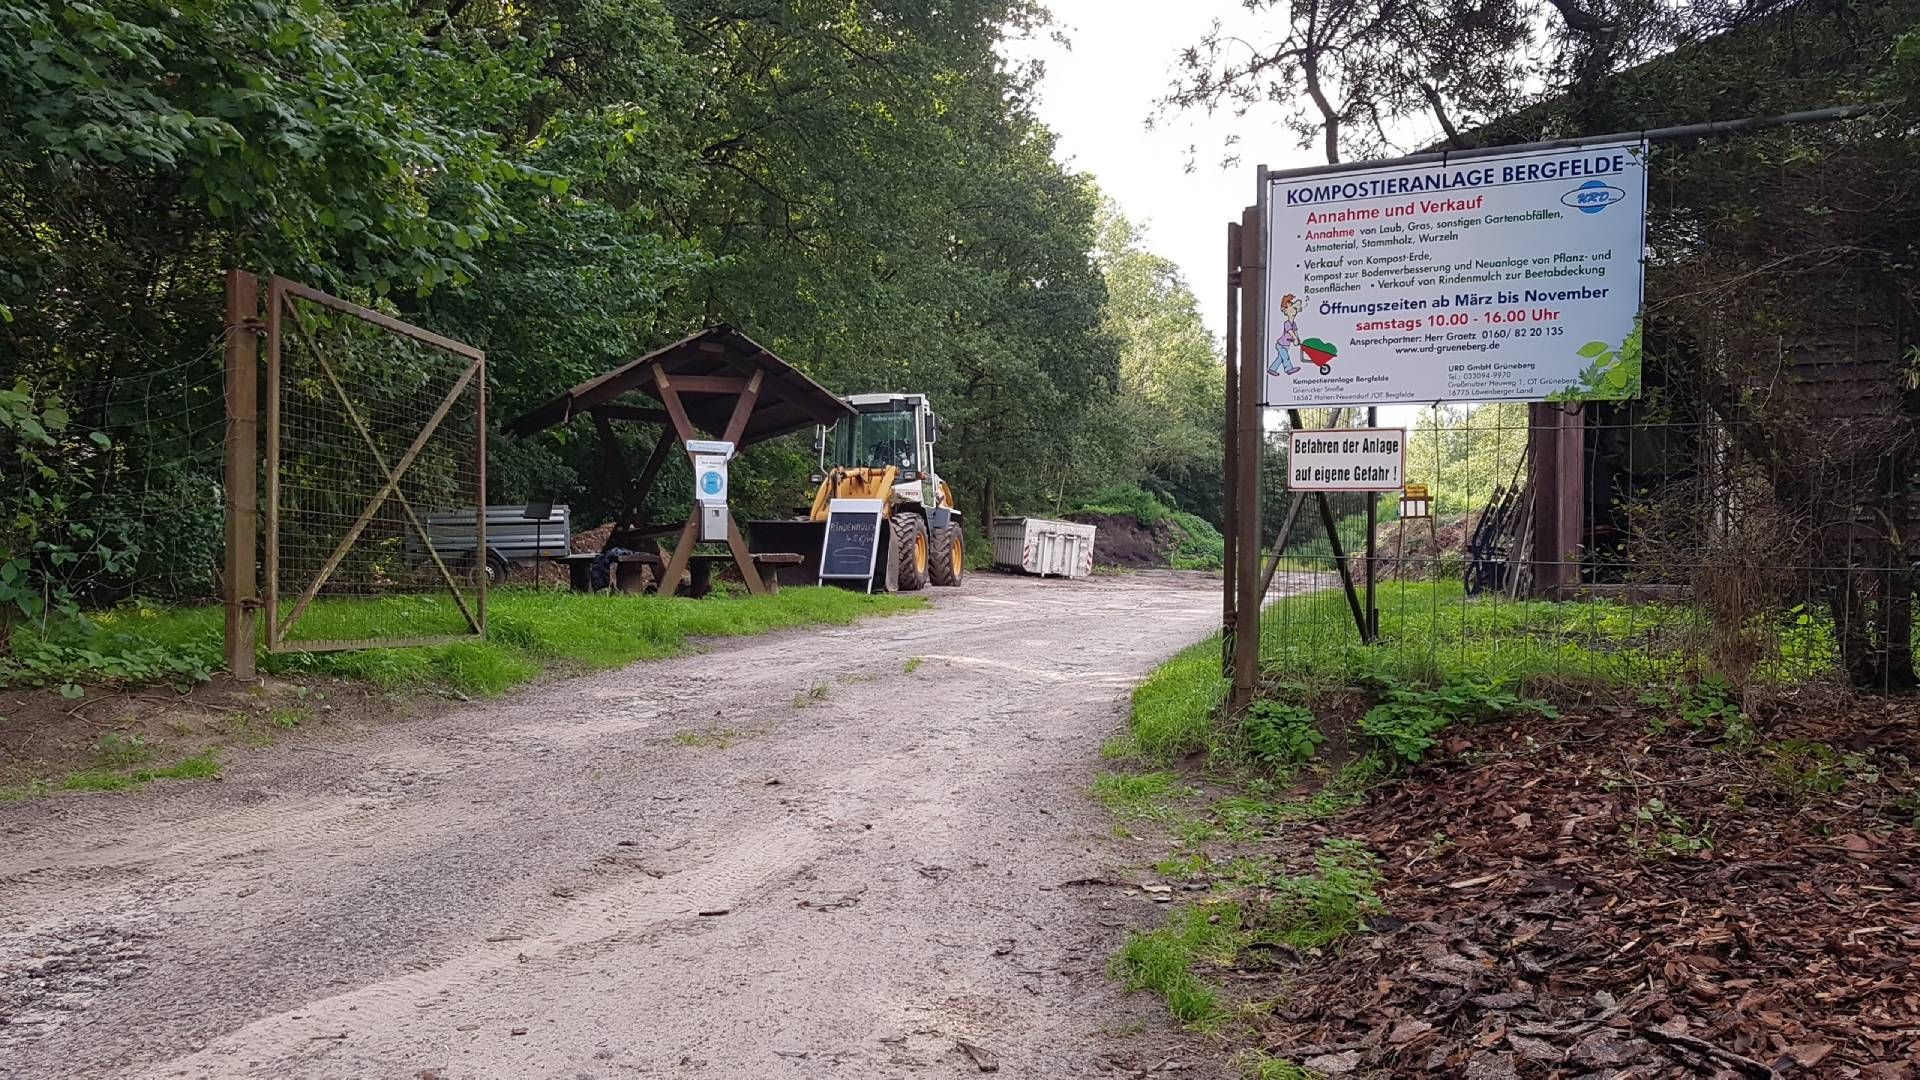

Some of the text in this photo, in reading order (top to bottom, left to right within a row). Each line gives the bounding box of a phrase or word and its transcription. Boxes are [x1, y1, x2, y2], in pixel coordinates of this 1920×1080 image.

[1287, 155, 1624, 204] KOMPOSTIERANLAGE BERGFELDE
[1306, 195, 1483, 224] Annahme und Verkauf
[1305, 209, 1563, 240] Annahme von Laub, Gras, sonstigen Gartenabfällen,
[1305, 231, 1458, 252] Astmaterial, Stammholz, Wurzeln
[1304, 251, 1432, 269] Verkauf von Kompost-Erde,
[1304, 272, 1342, 283] Kompost
[1362, 265, 1451, 278] Bodenverbesserung
[1454, 260, 1472, 271] und
[1475, 257, 1528, 269] Neuanlage
[1532, 257, 1549, 265] von
[1553, 252, 1588, 263] Pflanz-
[1591, 249, 1611, 261] und
[1304, 265, 1606, 294] Rasenflächen Verkauf von Rindenmulch zur Beetabdeckung
[1319, 286, 1610, 316] Öffnungszeiten ab März bis November
[1355, 318, 1422, 332] samstags
[1427, 313, 1469, 327] 10.00
[1484, 310, 1526, 324] 16.00
[1531, 308, 1560, 321] Uhr
[1350, 335, 1422, 347] Ansprechpartner:
[1424, 333, 1444, 343] Herr
[1481, 329, 1511, 339] 0160/
[1514, 328, 1527, 338] 82
[1530, 327, 1542, 337] 20
[1545, 326, 1564, 336] 135
[1395, 341, 1500, 354] www.urd-grueneberg.de
[1467, 363, 1491, 371] GmbH
[1493, 362, 1535, 370] Grüneberg
[1293, 375, 1389, 386] Kompostieranlage Bergfelde
[1294, 438, 1399, 455] Befahren der Anlage
[1295, 466, 1312, 481] auf
[1314, 466, 1350, 483] eigene
[1354, 465, 1390, 481] Gefahr
